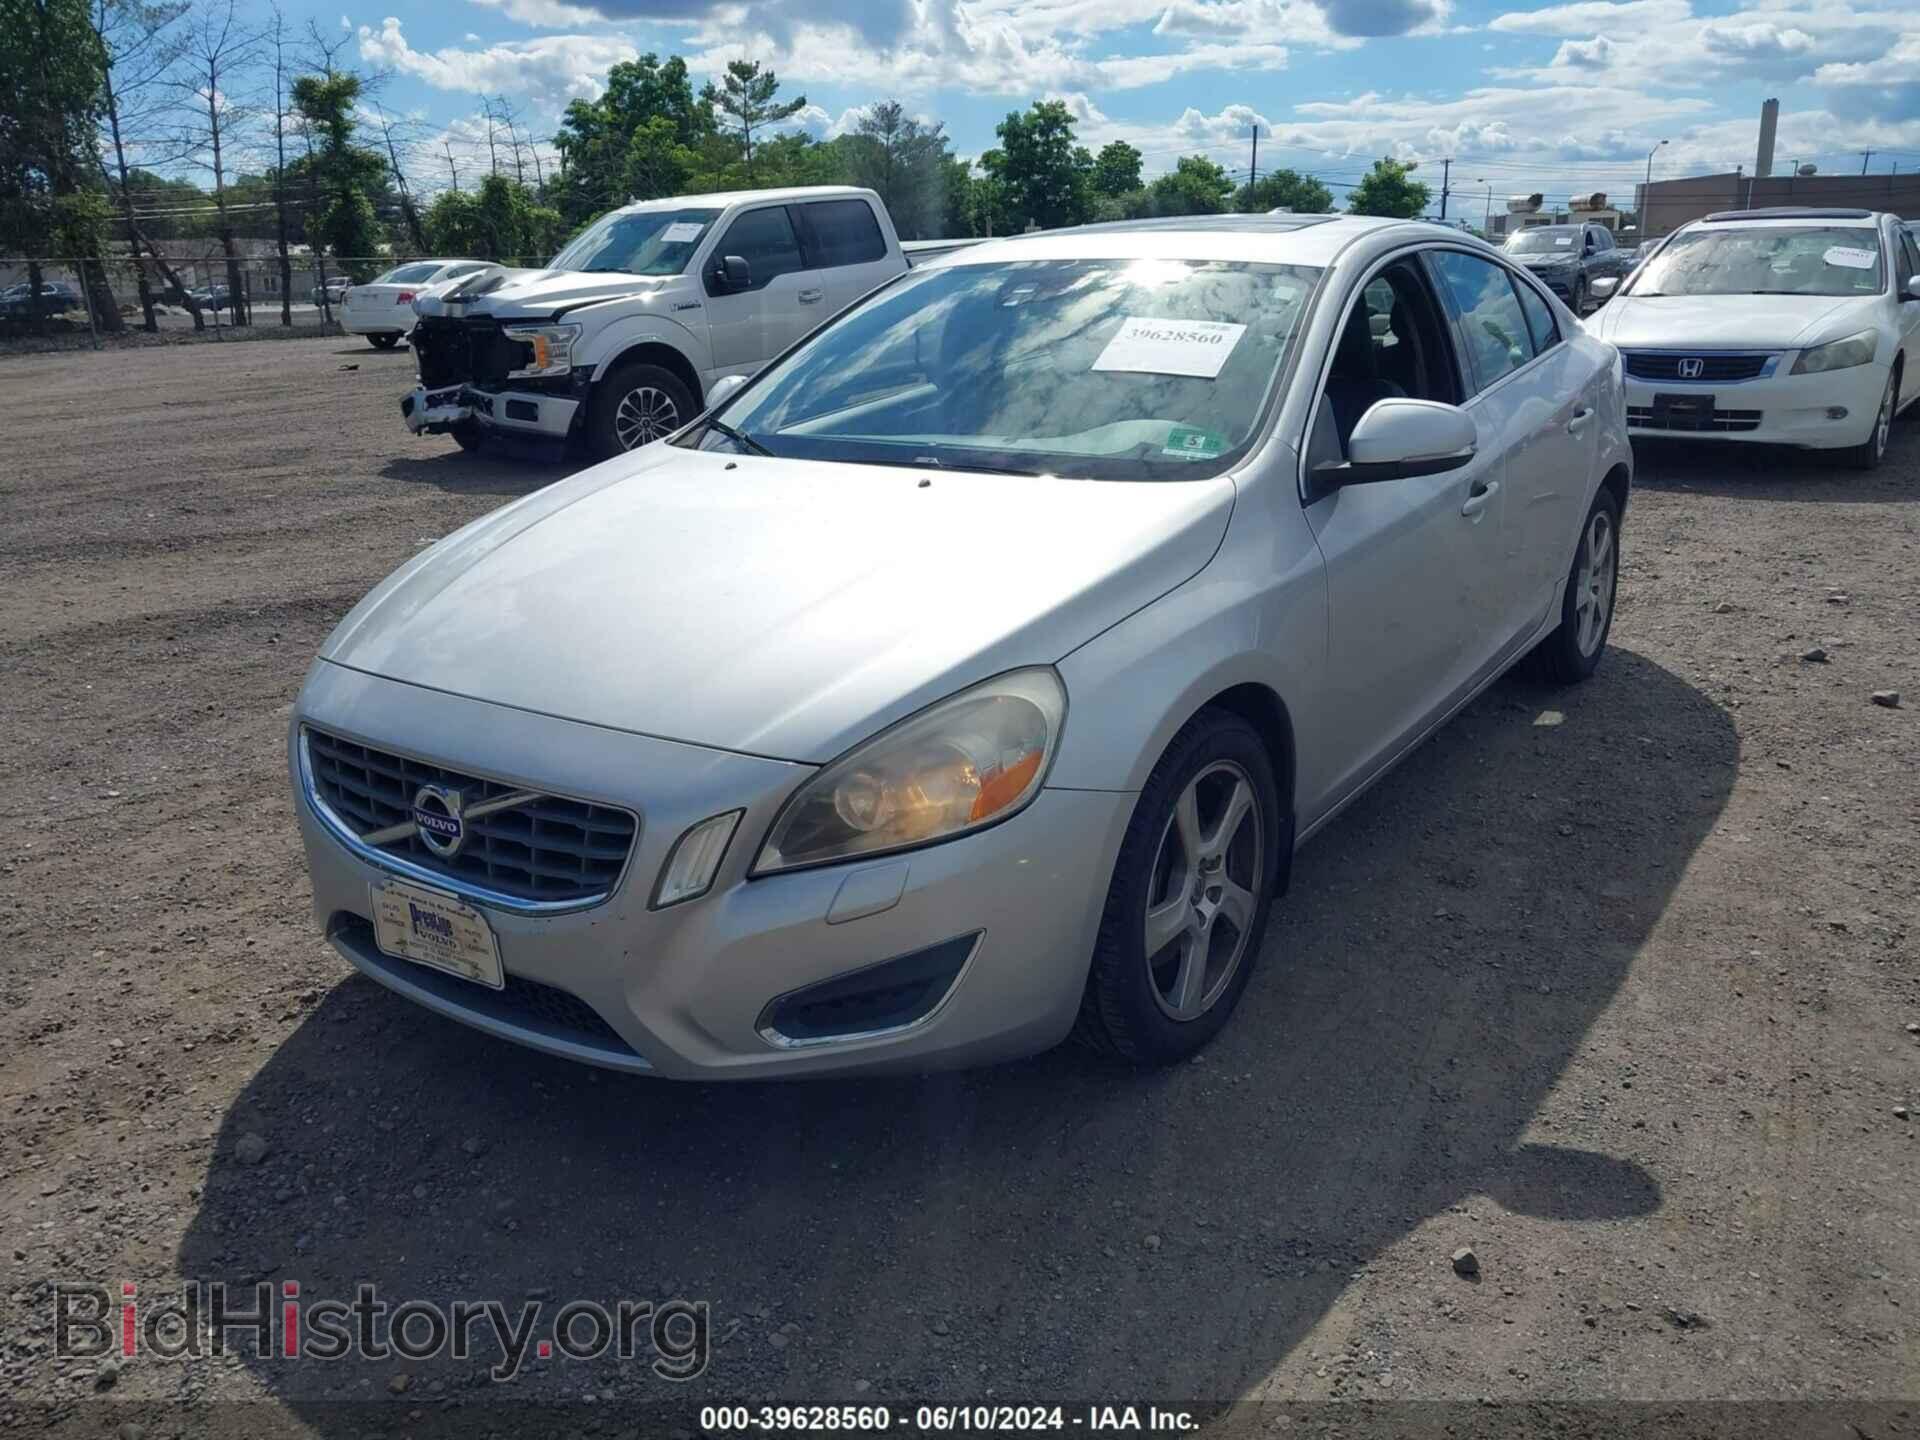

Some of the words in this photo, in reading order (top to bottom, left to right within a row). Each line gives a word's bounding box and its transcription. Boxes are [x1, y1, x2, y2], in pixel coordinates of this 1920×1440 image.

[1126, 328, 1224, 345] 39628560
[415, 811, 458, 832] VOLVO
[419, 929, 458, 949] VOLVO
